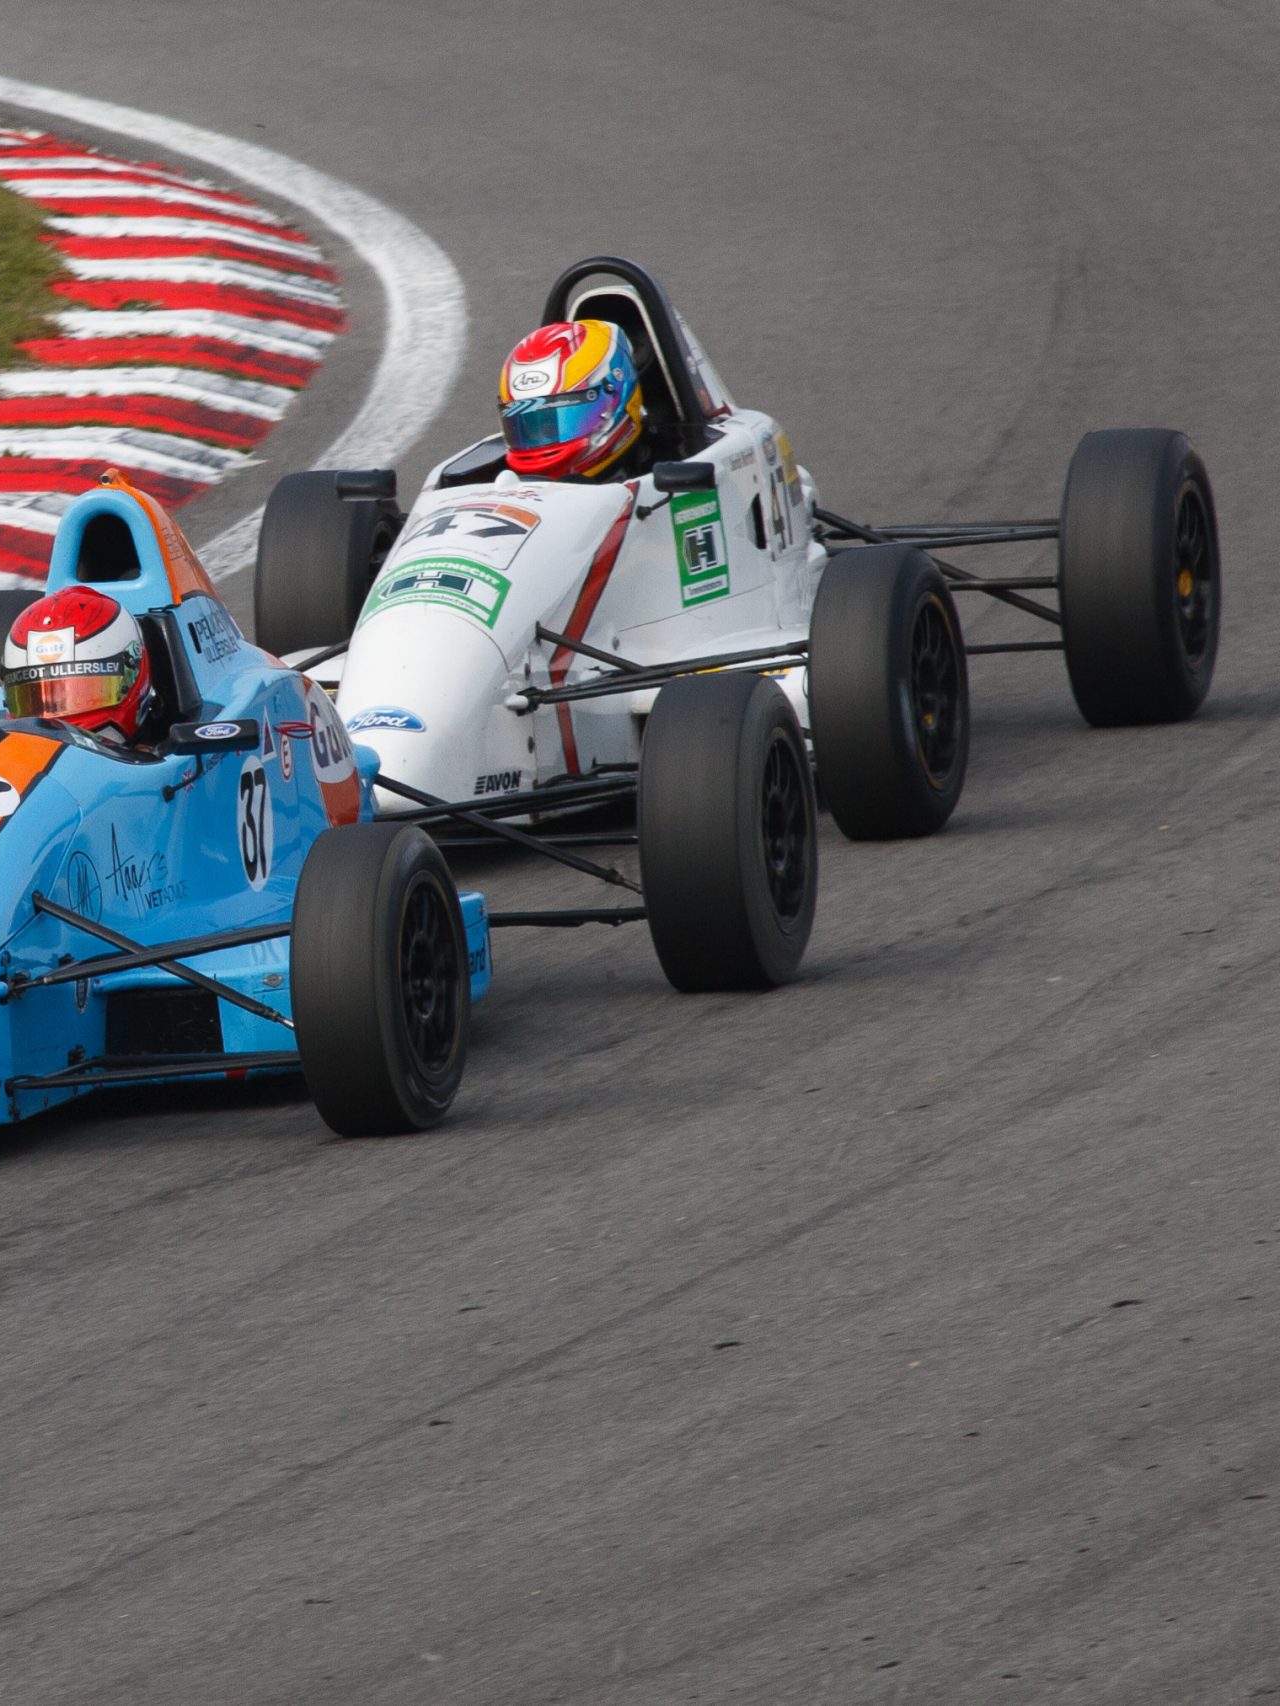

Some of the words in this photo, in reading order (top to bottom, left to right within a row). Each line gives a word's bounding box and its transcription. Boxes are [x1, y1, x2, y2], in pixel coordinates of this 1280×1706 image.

[399, 513, 529, 547] 47
[50, 661, 120, 677] ULLERSLEV
[347, 711, 410, 732] Ford
[485, 770, 522, 793] AVON
[240, 767, 267, 883] 37
